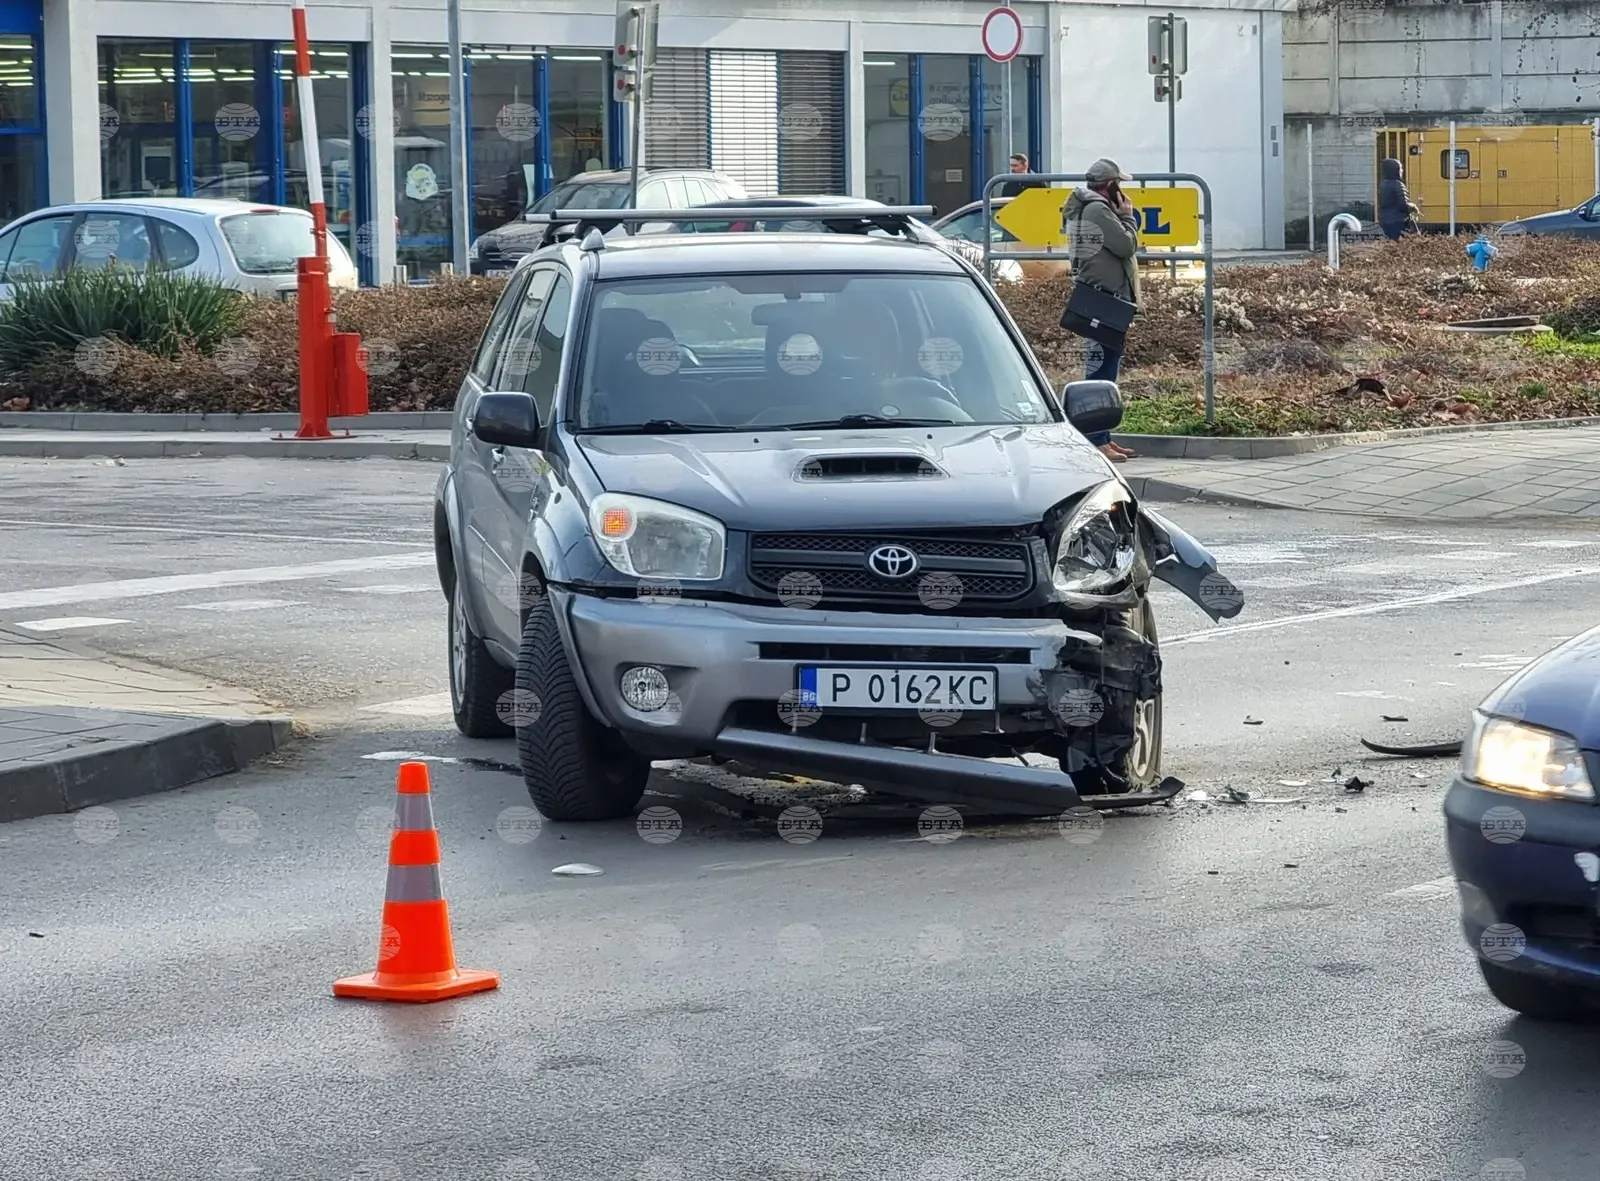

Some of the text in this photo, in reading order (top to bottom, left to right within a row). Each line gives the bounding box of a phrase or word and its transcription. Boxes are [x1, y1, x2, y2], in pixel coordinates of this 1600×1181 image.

[803, 691, 816, 701] BG
[832, 673, 988, 705] P 0162KC
